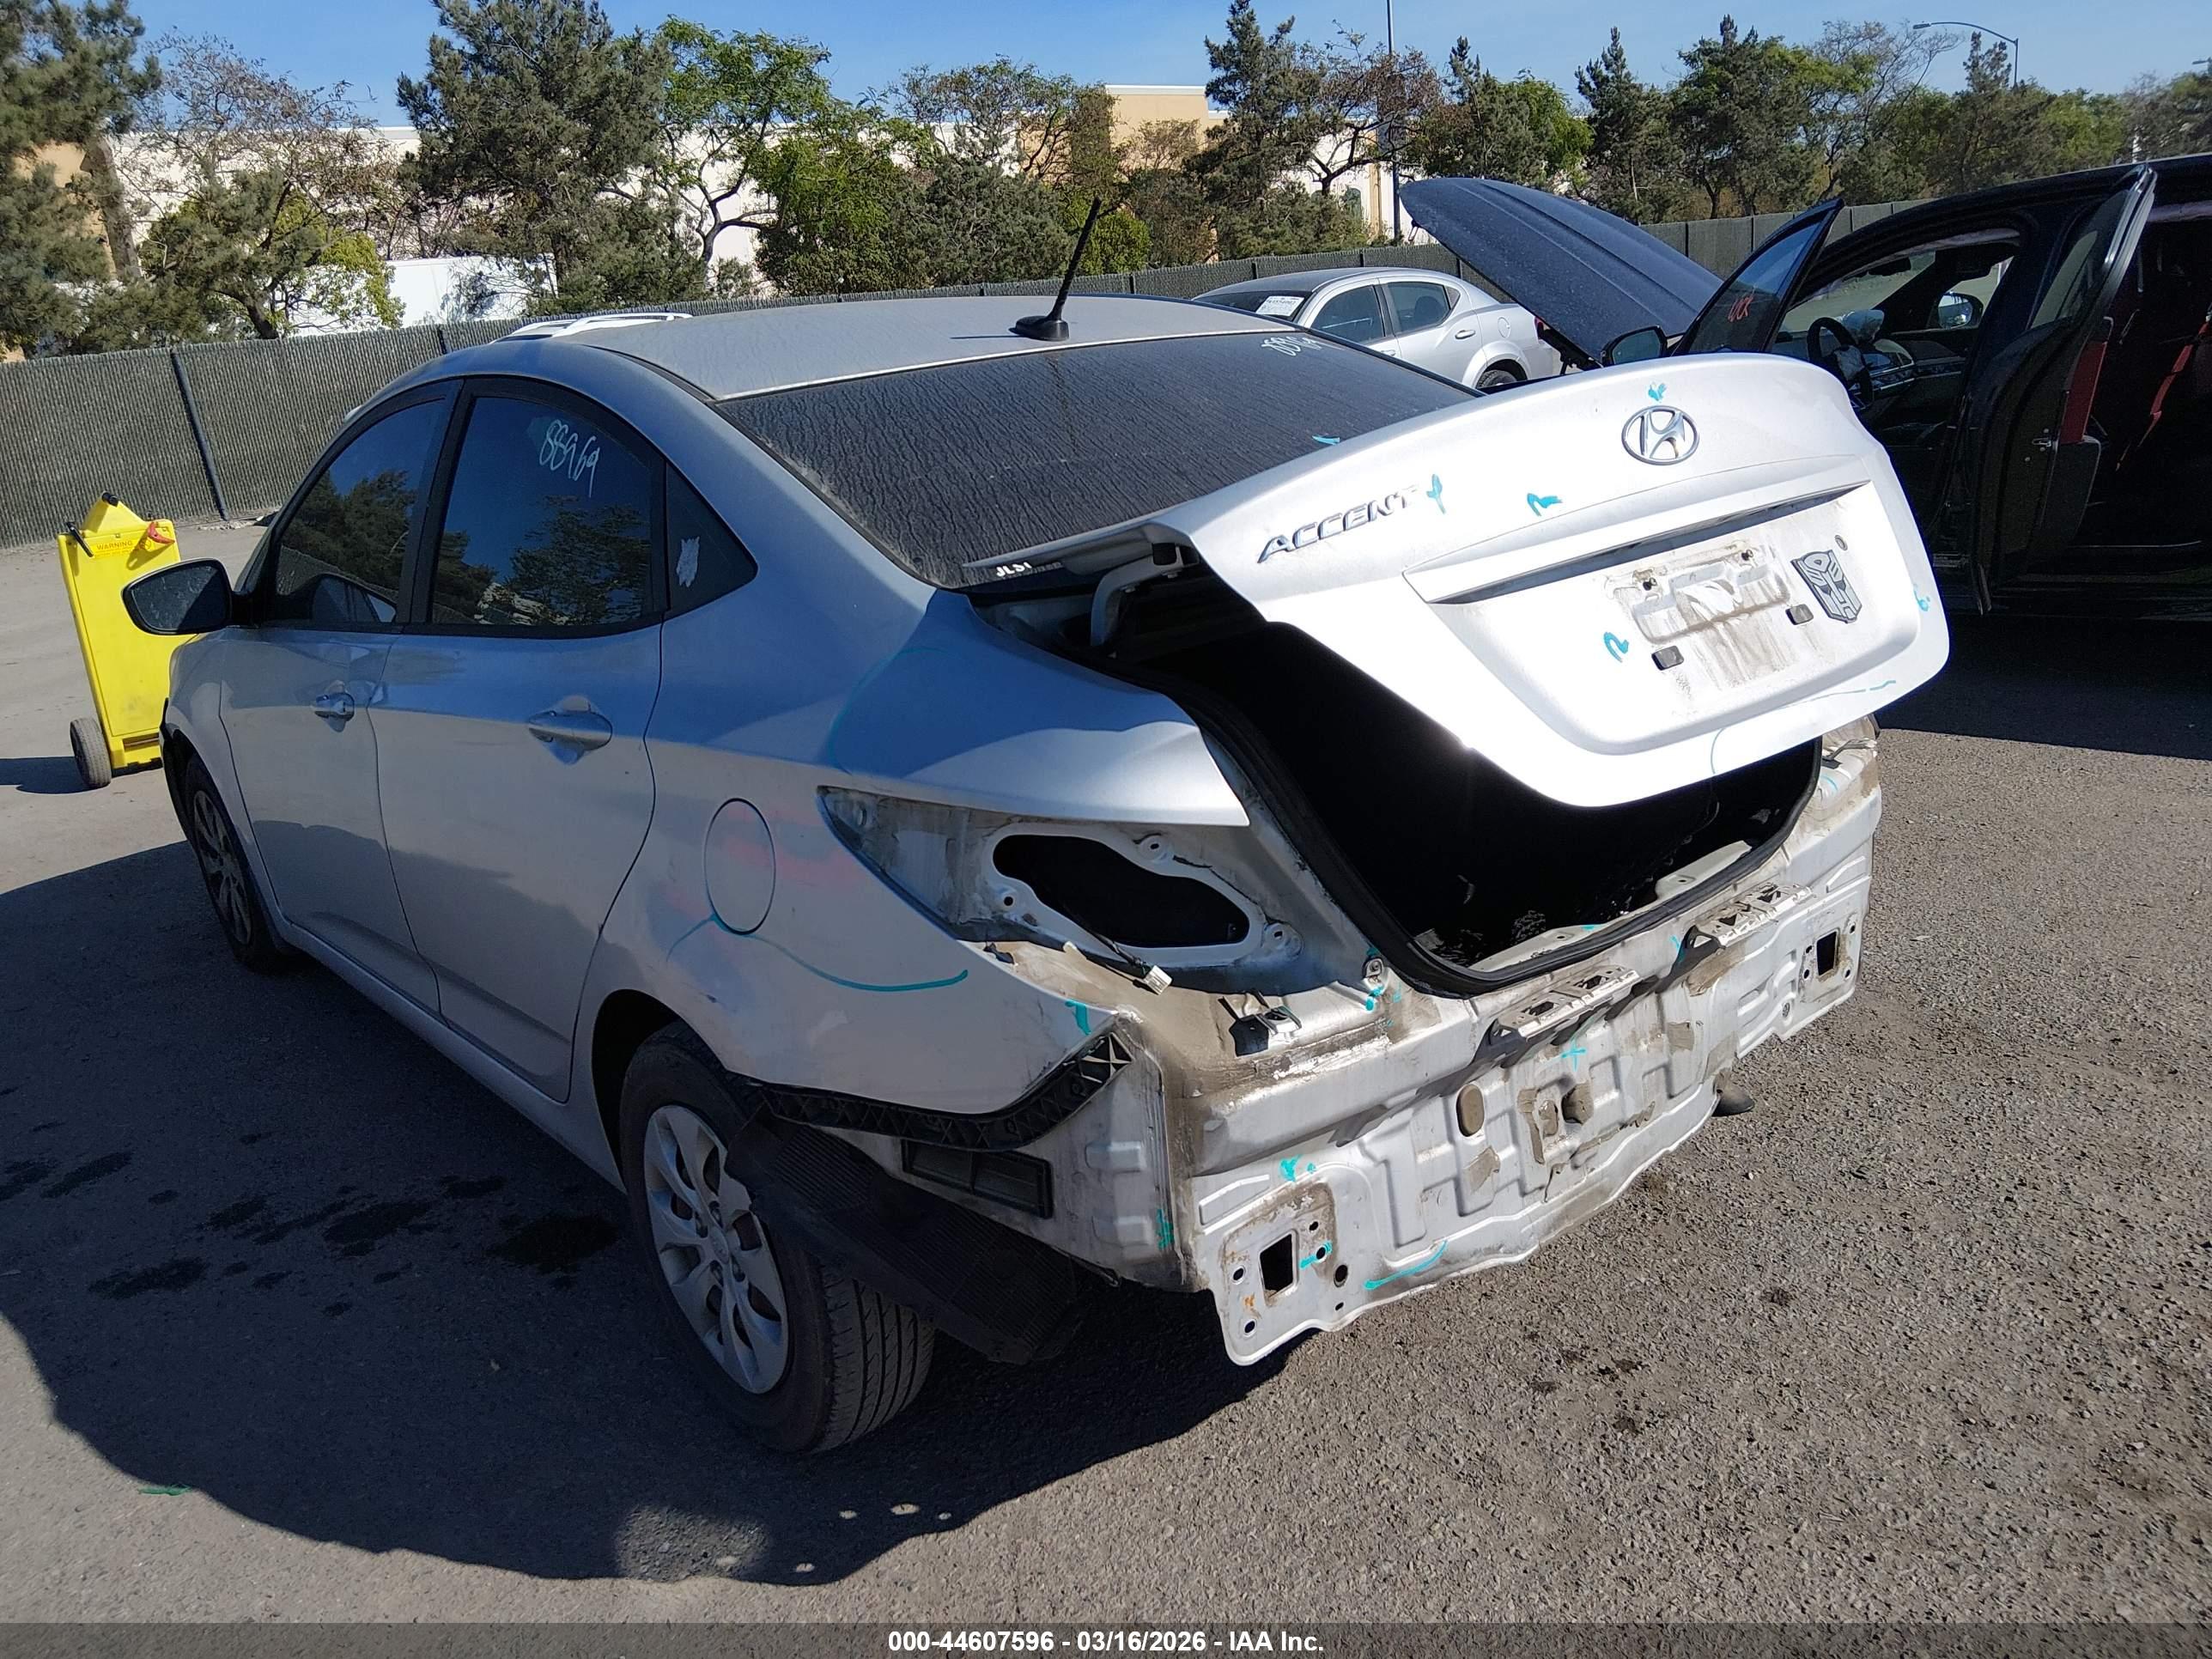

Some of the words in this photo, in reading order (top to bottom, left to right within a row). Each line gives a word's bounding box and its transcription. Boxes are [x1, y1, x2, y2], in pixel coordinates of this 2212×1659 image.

[538, 419, 600, 498] 88969
[96, 539, 133, 551] WARNING
[1257, 484, 1418, 564] ACCENT
